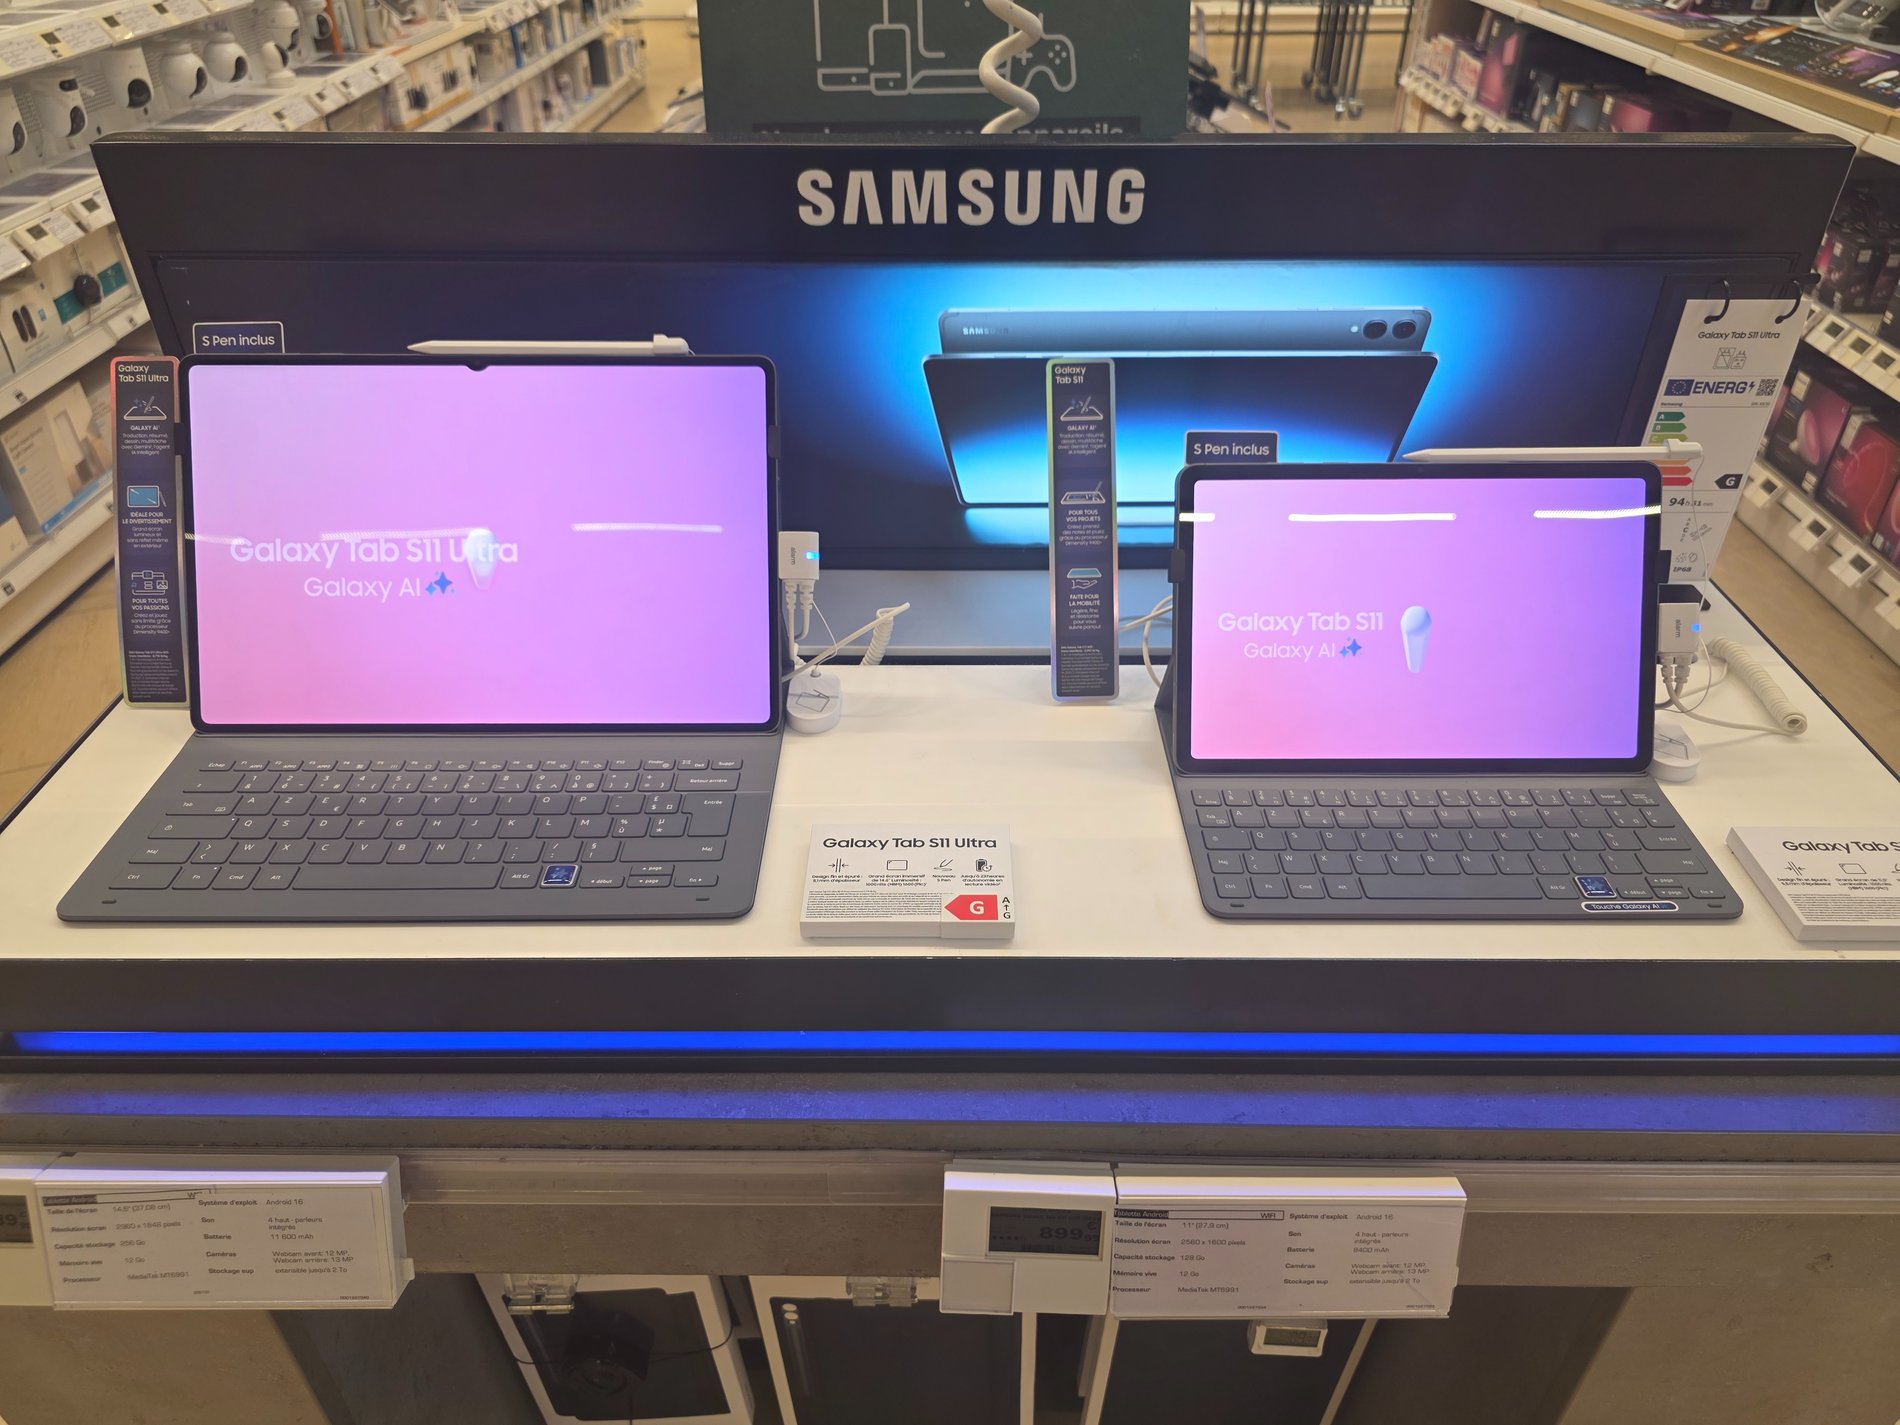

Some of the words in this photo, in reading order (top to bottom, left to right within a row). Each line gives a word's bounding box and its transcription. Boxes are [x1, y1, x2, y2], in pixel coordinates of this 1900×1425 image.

[797, 168, 1145, 226] SAMSUNG
[202, 336, 210, 346] S
[212, 335, 236, 346] Pen
[239, 334, 275, 346] inclus
[1698, 331, 1730, 340] Galaxy
[1731, 331, 1747, 339] Tab
[1747, 331, 1759, 339] S11
[1760, 331, 1780, 339] Ultra
[118, 364, 149, 374] Galaxy
[1054, 366, 1086, 376] Galaxy
[136, 374, 147, 382] S11
[148, 374, 169, 383] Ultra
[1055, 376, 1071, 384] Tab
[1072, 376, 1084, 384] S11
[1692, 381, 1748, 394] ENERG
[1193, 443, 1201, 455] S
[1204, 443, 1229, 455] Pen
[1232, 443, 1270, 456] inclus
[1725, 477, 1735, 486] G
[1669, 497, 1685, 507] 94
[230, 537, 339, 568] Galaxy
[347, 538, 399, 562] Tab
[406, 538, 439, 562] S11
[449, 539, 518, 563] Utra
[303, 577, 393, 603] Galaxy
[399, 577, 421, 597] AI
[1217, 612, 1304, 635] Galaxy
[1307, 611, 1350, 631] Tab
[1355, 611, 1384, 631] S11
[1243, 643, 1313, 662] Galaxy
[1318, 643, 1335, 658] AI
[823, 838, 889, 850] Galaxy
[892, 838, 925, 848] Tab
[929, 838, 951, 848] S11
[954, 838, 997, 848] Ultra
[1782, 841, 1851, 854] Galaxy
[1850, 841, 1889, 852] Tab
[1889, 841, 1900, 851] S
[1002, 896, 1010, 904] A
[969, 900, 985, 915] G
[1039, 1226, 1083, 1240] 899
